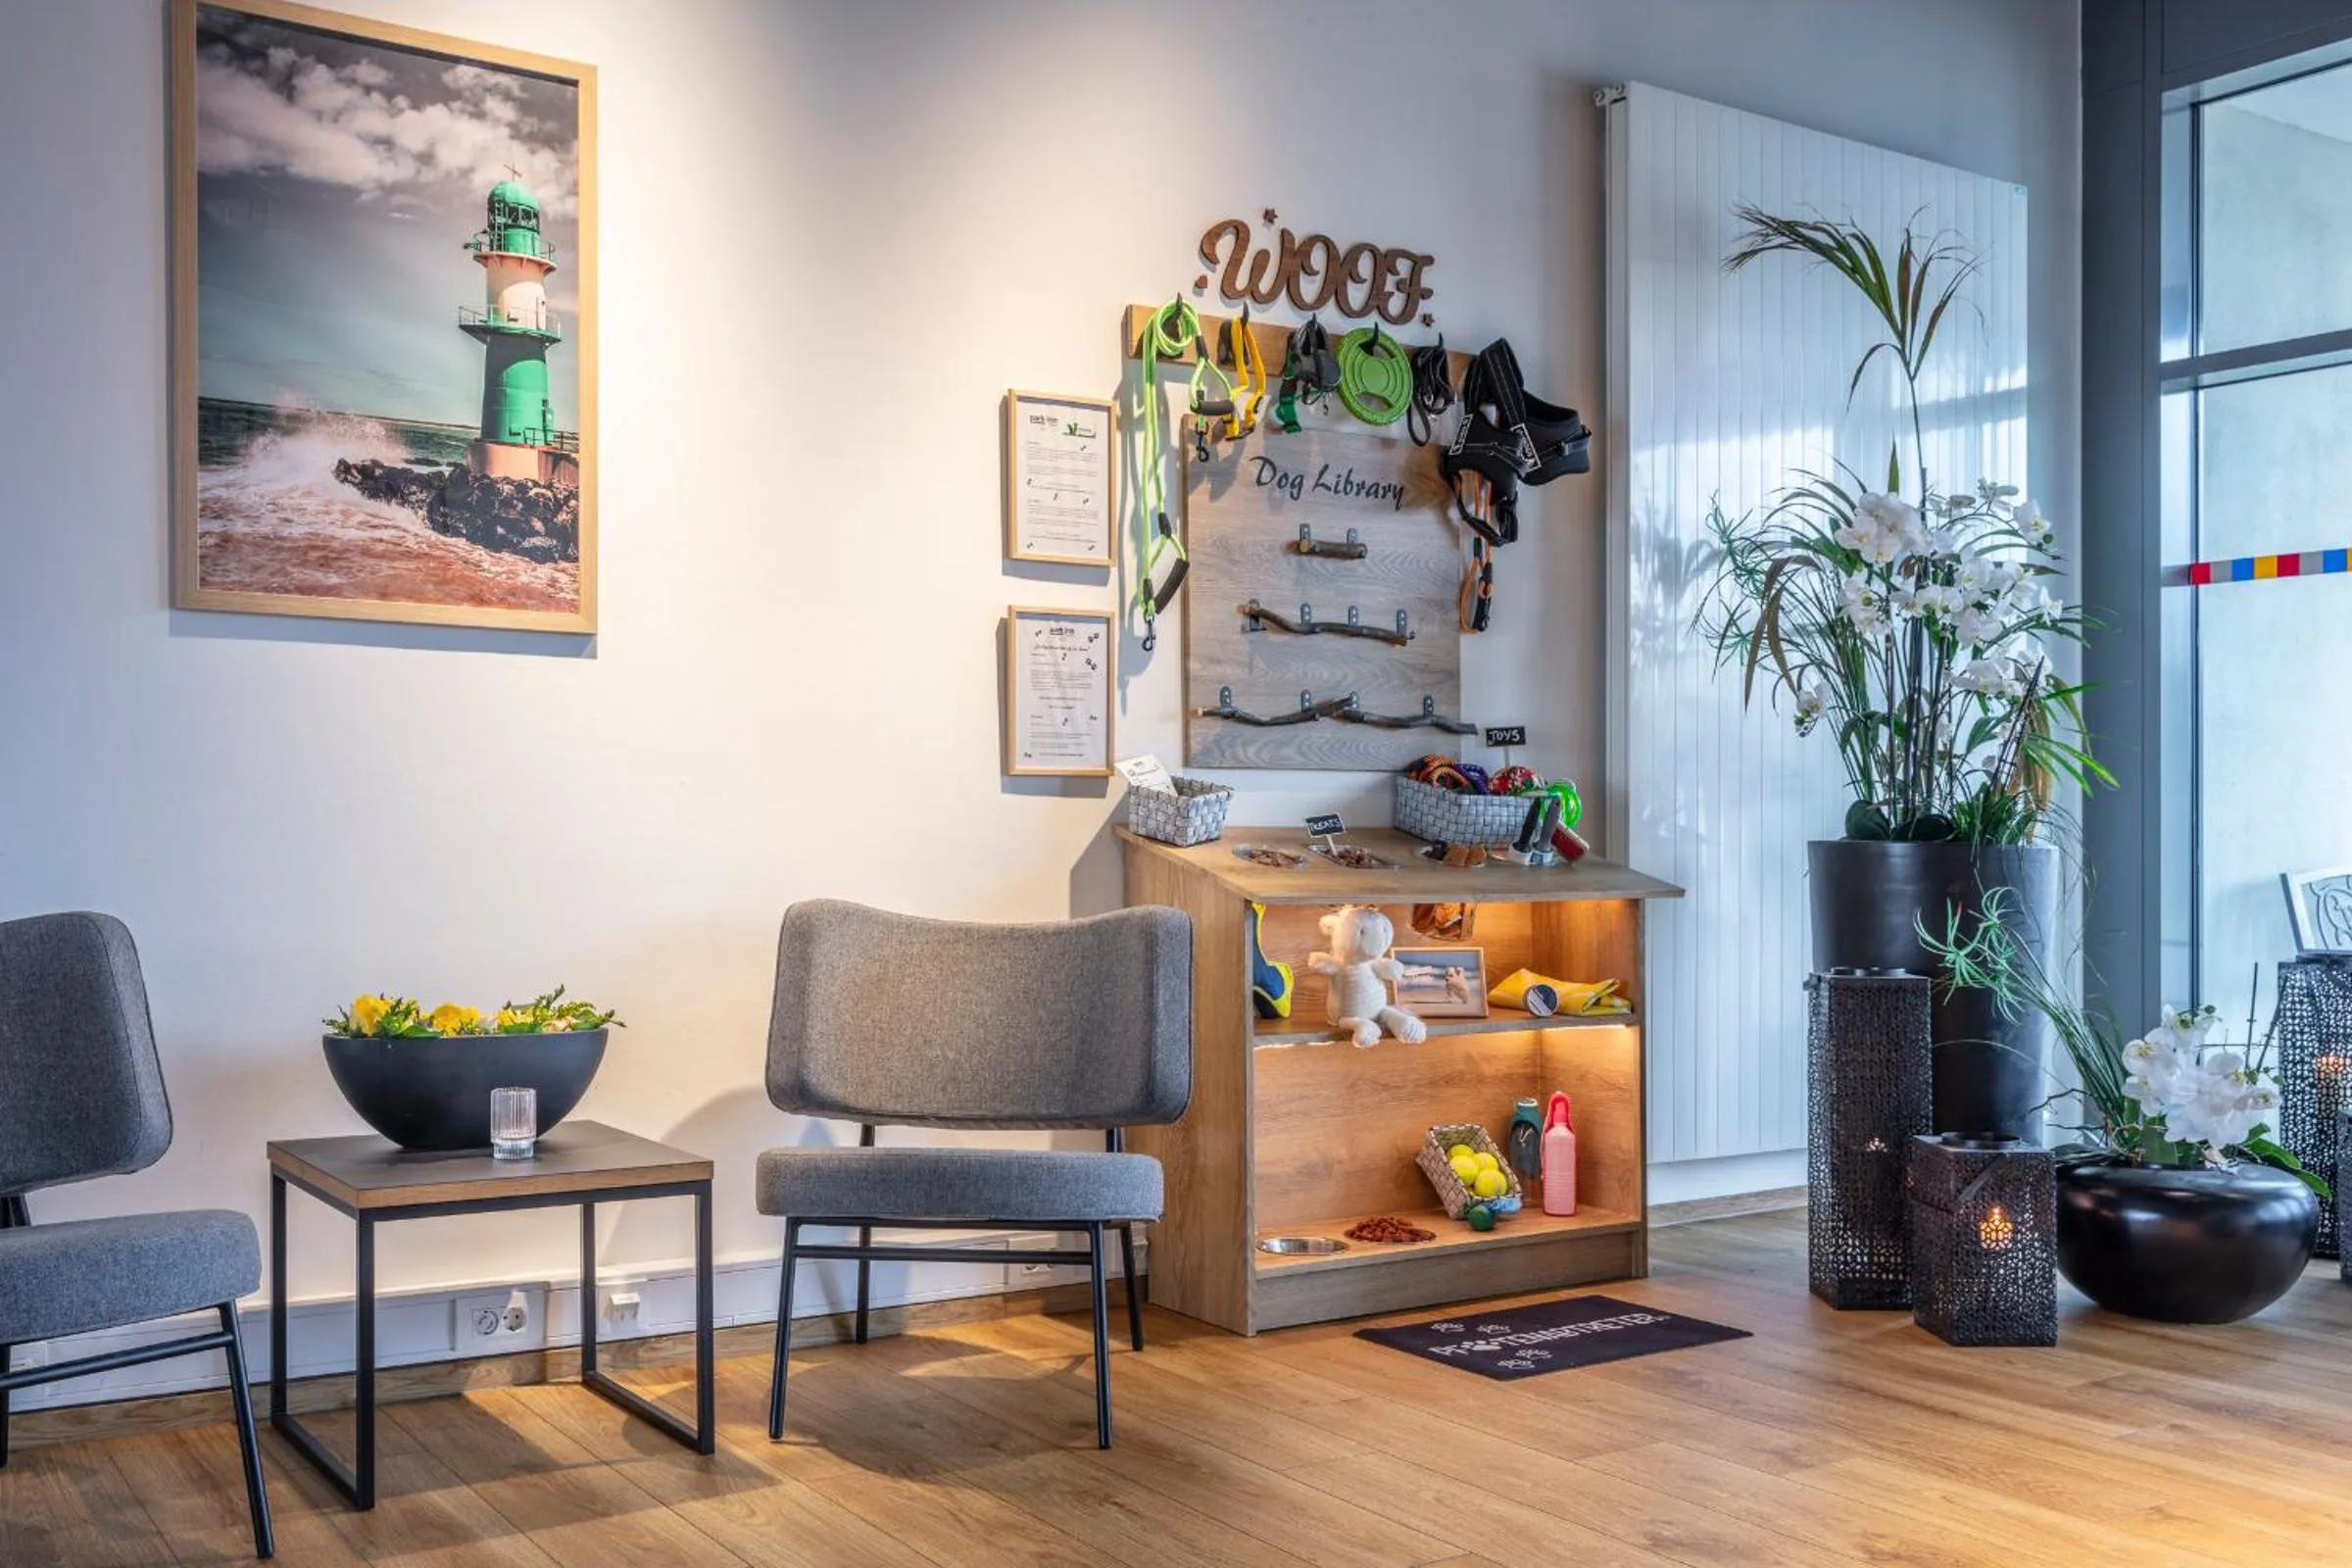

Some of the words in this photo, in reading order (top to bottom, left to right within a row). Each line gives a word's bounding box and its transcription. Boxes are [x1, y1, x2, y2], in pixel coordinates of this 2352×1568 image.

[1200, 219, 1435, 324] WOOF
[1250, 456, 1304, 501] Dog
[1311, 464, 1404, 512] Library
[1489, 729, 1520, 742] TOYS
[1428, 1313, 1671, 1356] PFTENABTRETER
